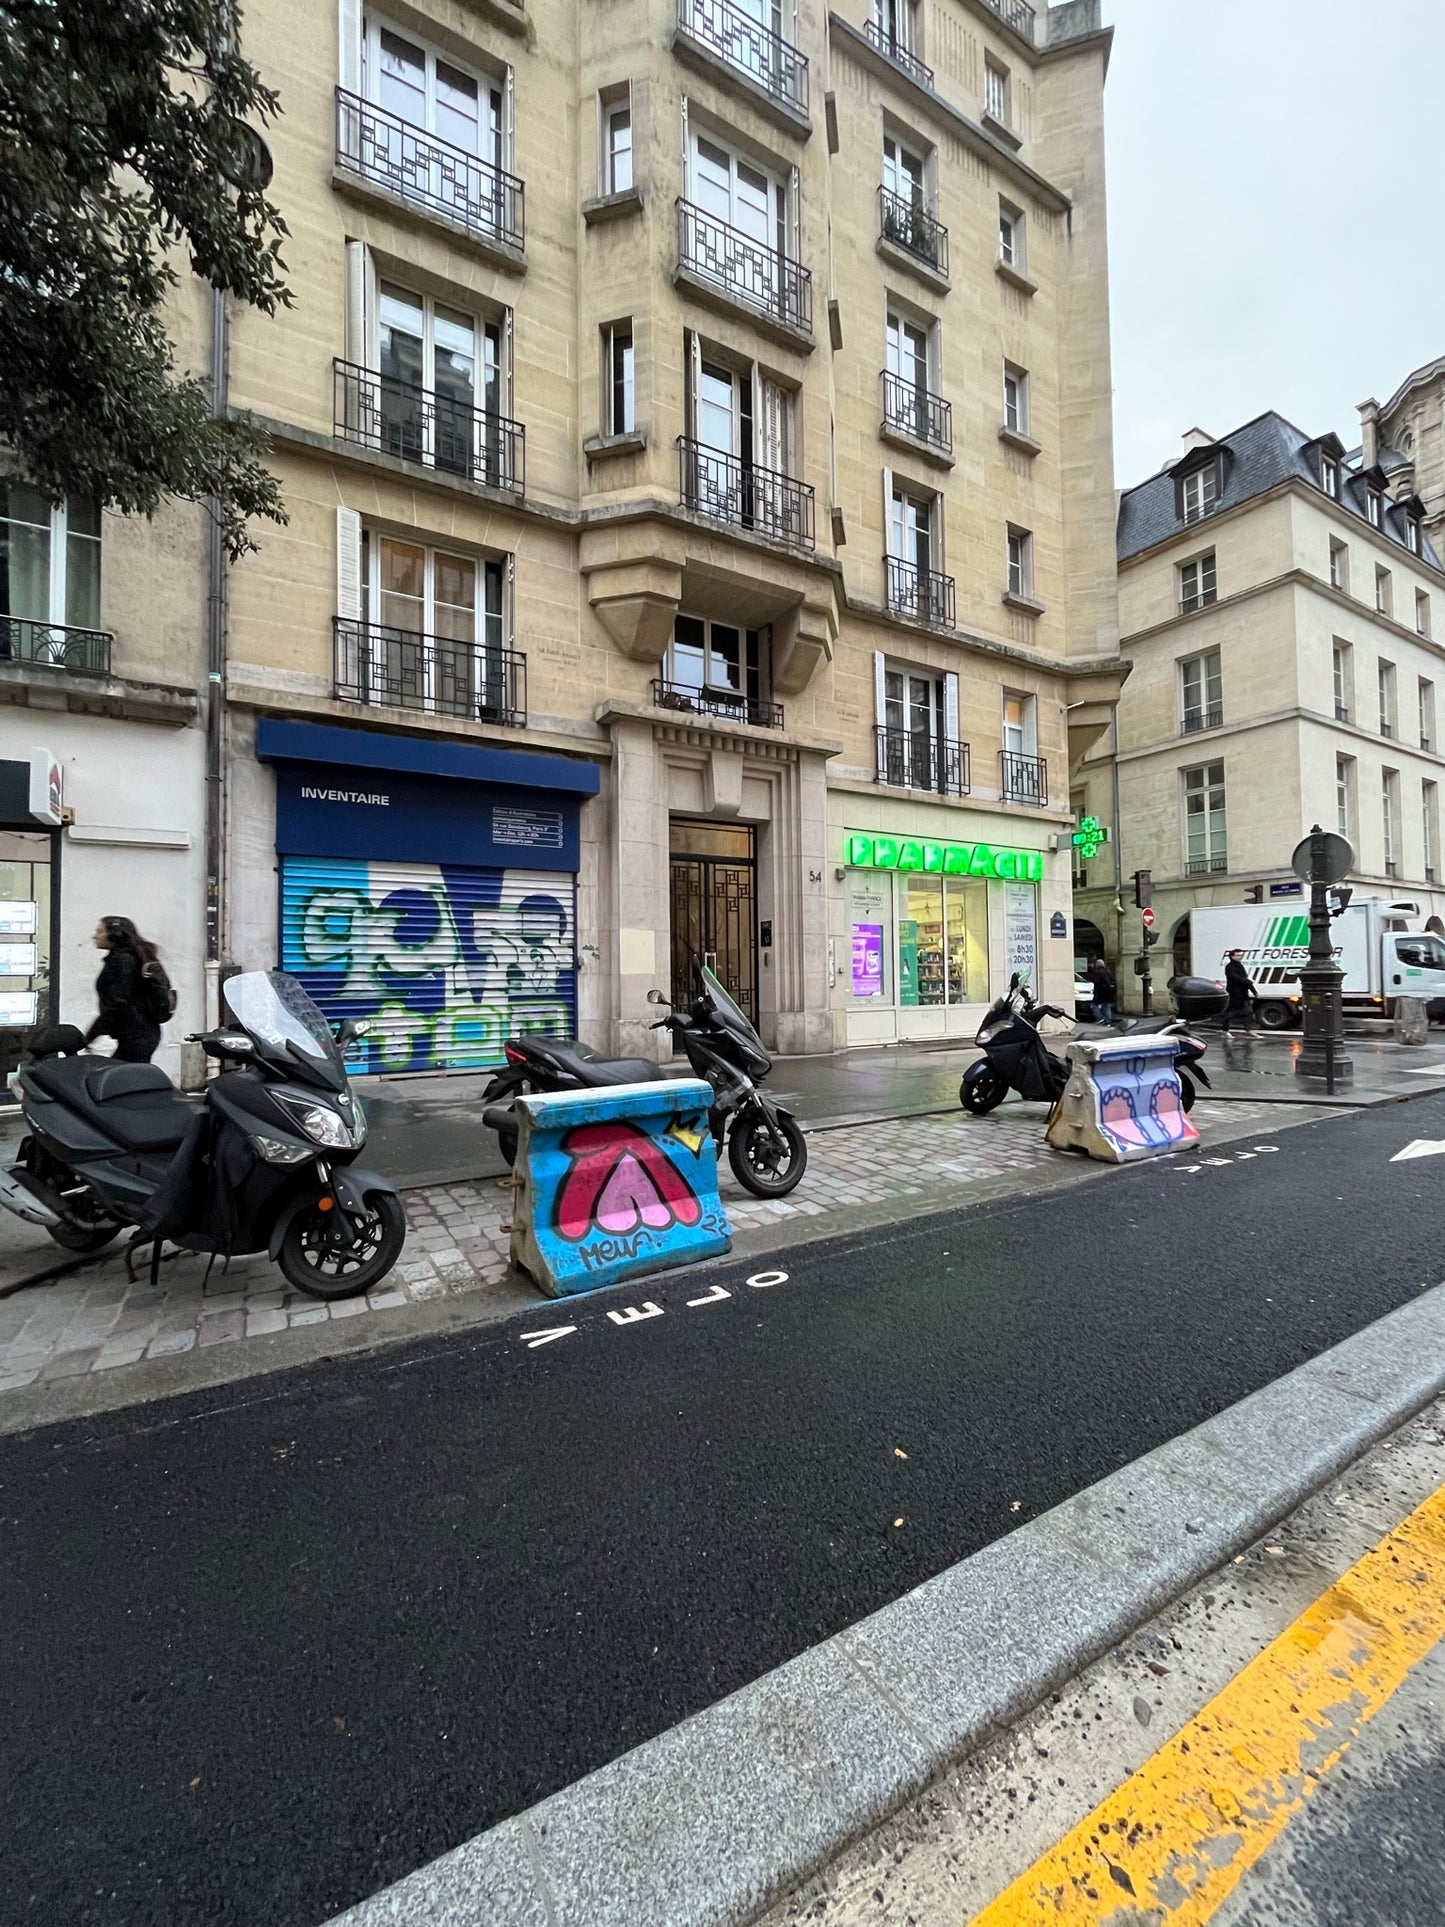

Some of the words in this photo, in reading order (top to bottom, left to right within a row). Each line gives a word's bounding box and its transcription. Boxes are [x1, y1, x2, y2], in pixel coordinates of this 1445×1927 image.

[301, 786, 390, 806] INVENTAIRE
[1073, 830, 1105, 845] 09:21
[850, 836, 1043, 881] PHARMACIE
[809, 870, 822, 883] 54
[1016, 944, 1034, 953] 8h30
[1013, 955, 1034, 964] 20h30
[519, 1270, 790, 1349] VELO
